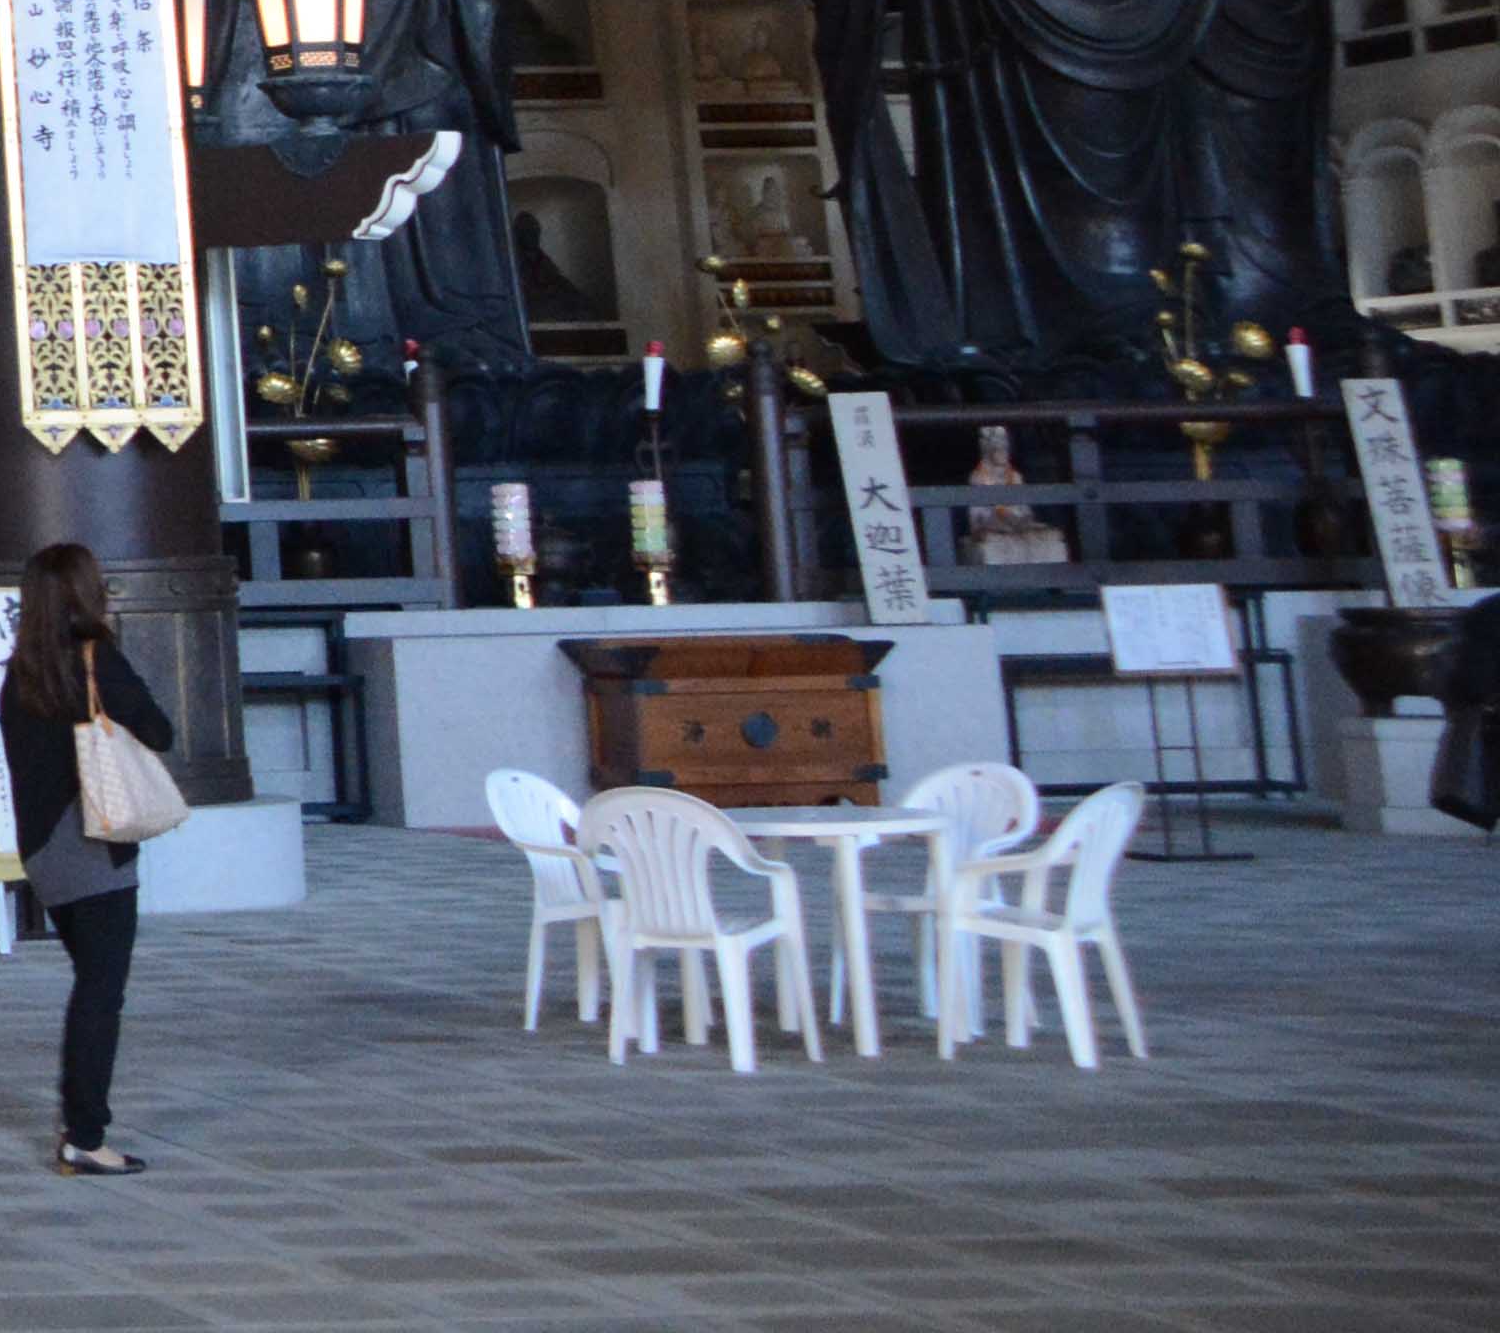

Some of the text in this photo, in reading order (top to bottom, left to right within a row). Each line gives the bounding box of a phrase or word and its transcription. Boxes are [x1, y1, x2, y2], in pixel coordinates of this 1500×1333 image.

[27, 46, 54, 153] 妙心寺
[859, 476, 917, 612] 大迦葉
[1358, 384, 1448, 605] 文殊菩薩像
